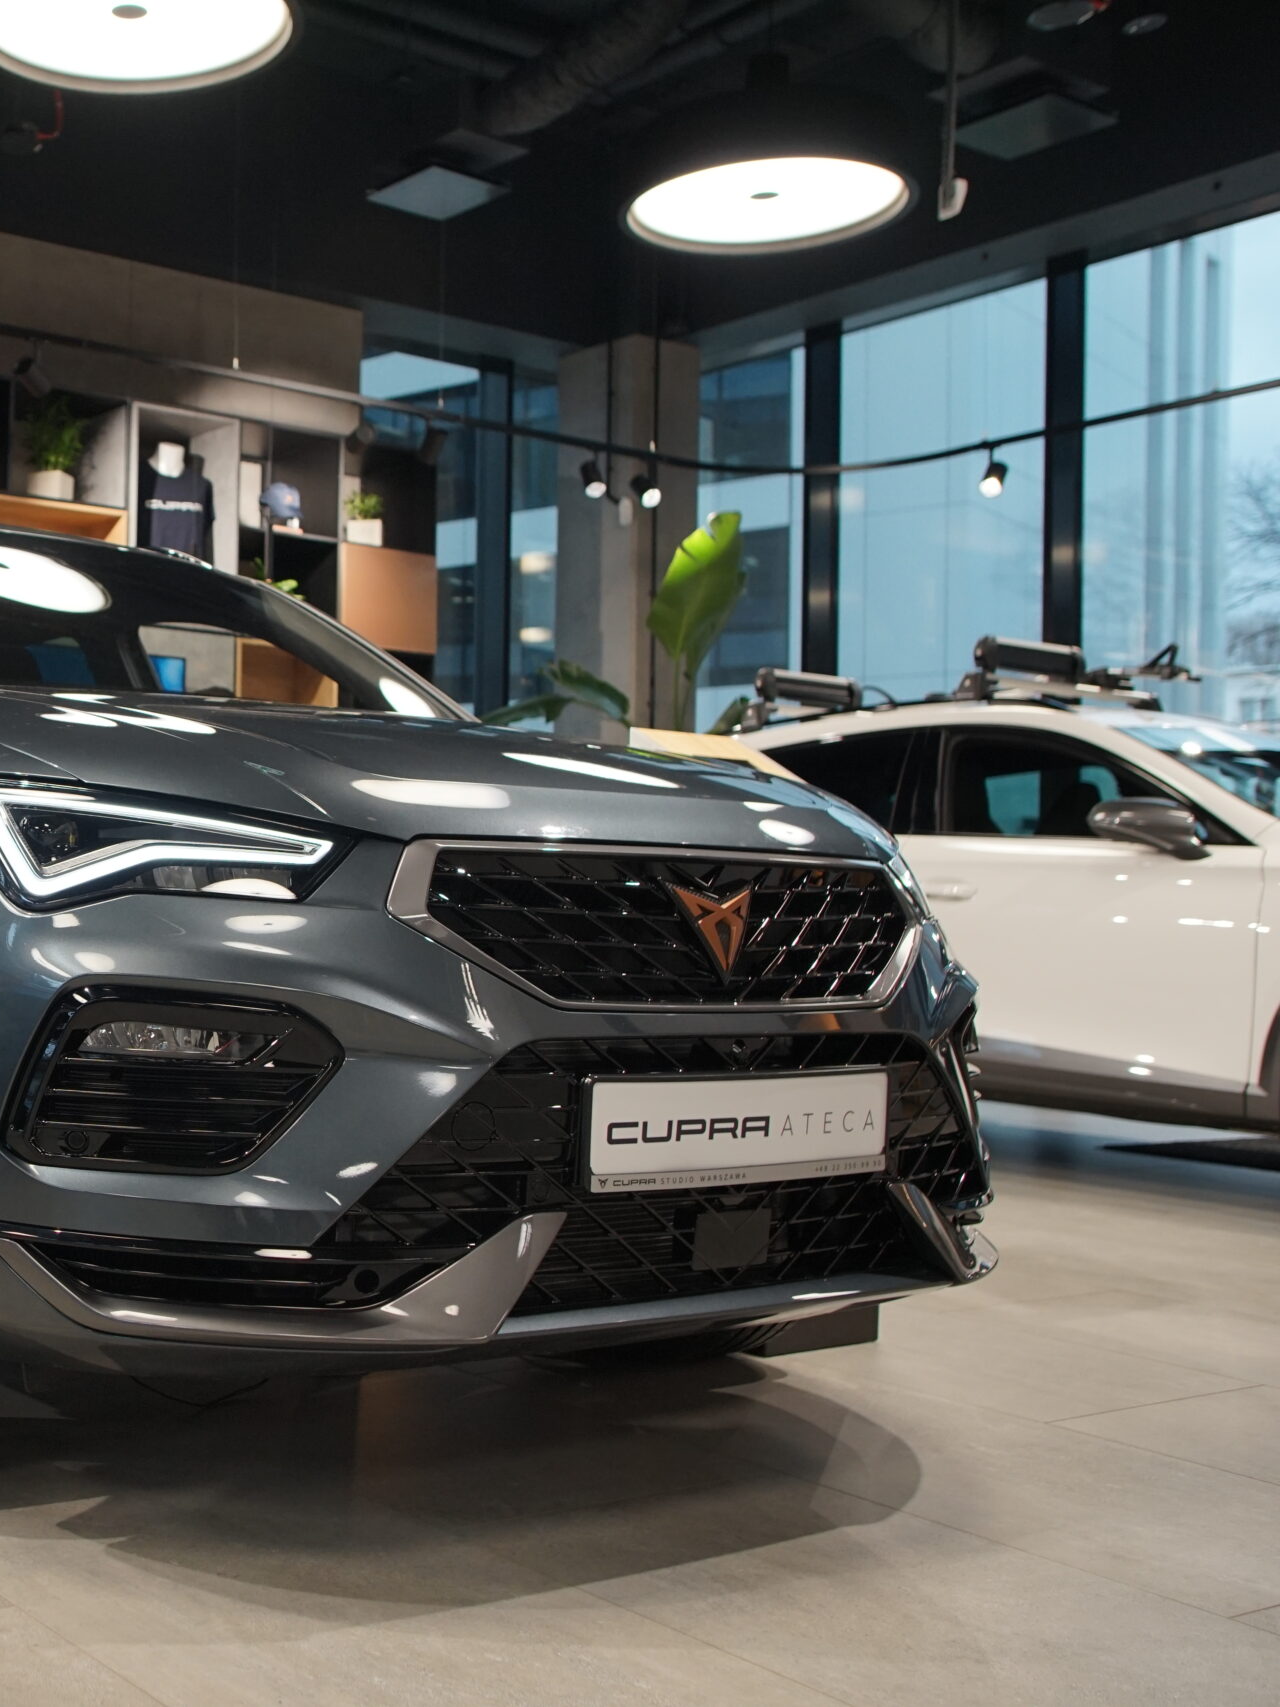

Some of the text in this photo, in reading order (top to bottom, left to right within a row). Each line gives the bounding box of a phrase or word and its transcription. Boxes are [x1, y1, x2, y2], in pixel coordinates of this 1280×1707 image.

[607, 1109, 875, 1145] CUPRA ATECA
[612, 1172, 747, 1187] CUPRA STUDIO WARSZAWA
